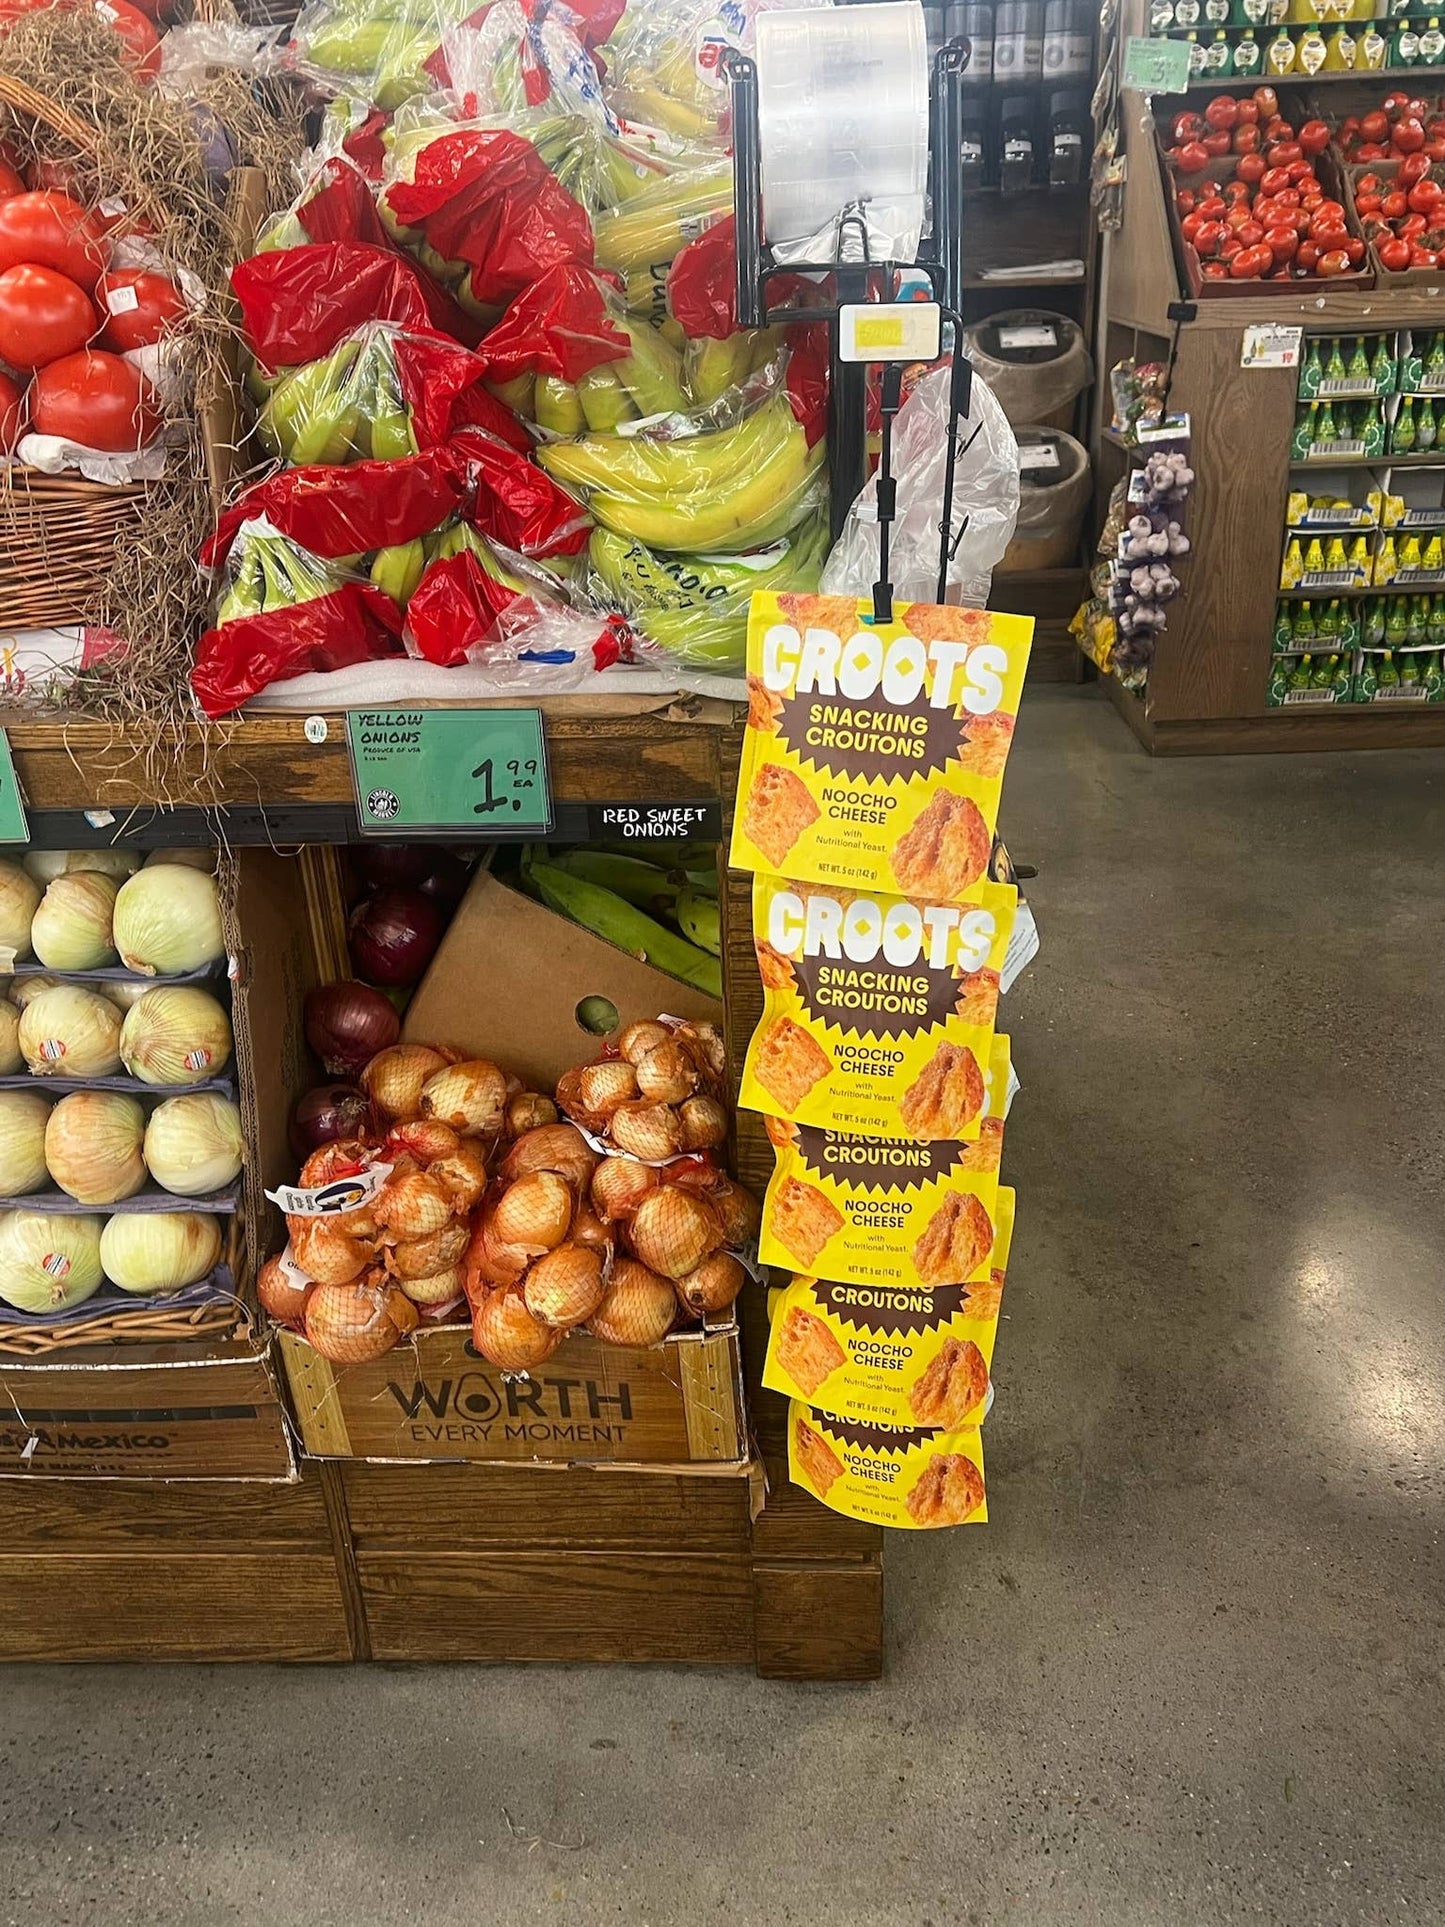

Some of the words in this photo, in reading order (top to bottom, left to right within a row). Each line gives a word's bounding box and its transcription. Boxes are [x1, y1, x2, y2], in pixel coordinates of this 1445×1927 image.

[762, 624, 1008, 715] CROOTS
[359, 714, 423, 727] YELLOW
[809, 704, 929, 735] SNACKING
[361, 731, 421, 743] ONIONS
[805, 728, 926, 758] CROUTONS
[513, 780, 534, 788] EA
[822, 788, 897, 809] NOOCHO
[603, 809, 640, 823] RED
[646, 808, 706, 823] SWEET
[828, 805, 887, 825] CHEESE
[623, 822, 688, 836] ONIONS
[843, 829, 863, 838] with
[816, 835, 861, 848] Nutritional
[768, 891, 996, 973] CROOTS
[818, 966, 930, 995] SNACKING
[815, 987, 928, 1016] CROUTONS
[834, 1044, 904, 1063] NOOCHO
[840, 1060, 895, 1077] CHEESE
[829, 1087, 872, 1100] Nutritional
[823, 1145, 931, 1167] CROUTONS
[845, 1200, 913, 1214] NOOCHO
[852, 1214, 904, 1228] CHEESE
[844, 1241, 884, 1252] Nutritional
[868, 1235, 885, 1243] with
[831, 1286, 934, 1314] CROUTONS
[848, 1339, 913, 1358] NOOCHO
[854, 1354, 904, 1370] CHEESE
[844, 1377, 883, 1390] Nutritional
[411, 1424, 493, 1441] EVERY
[505, 1423, 626, 1441] MOMENT
[843, 1453, 901, 1473] NOOCHO
[850, 1466, 894, 1483] CHEESE
